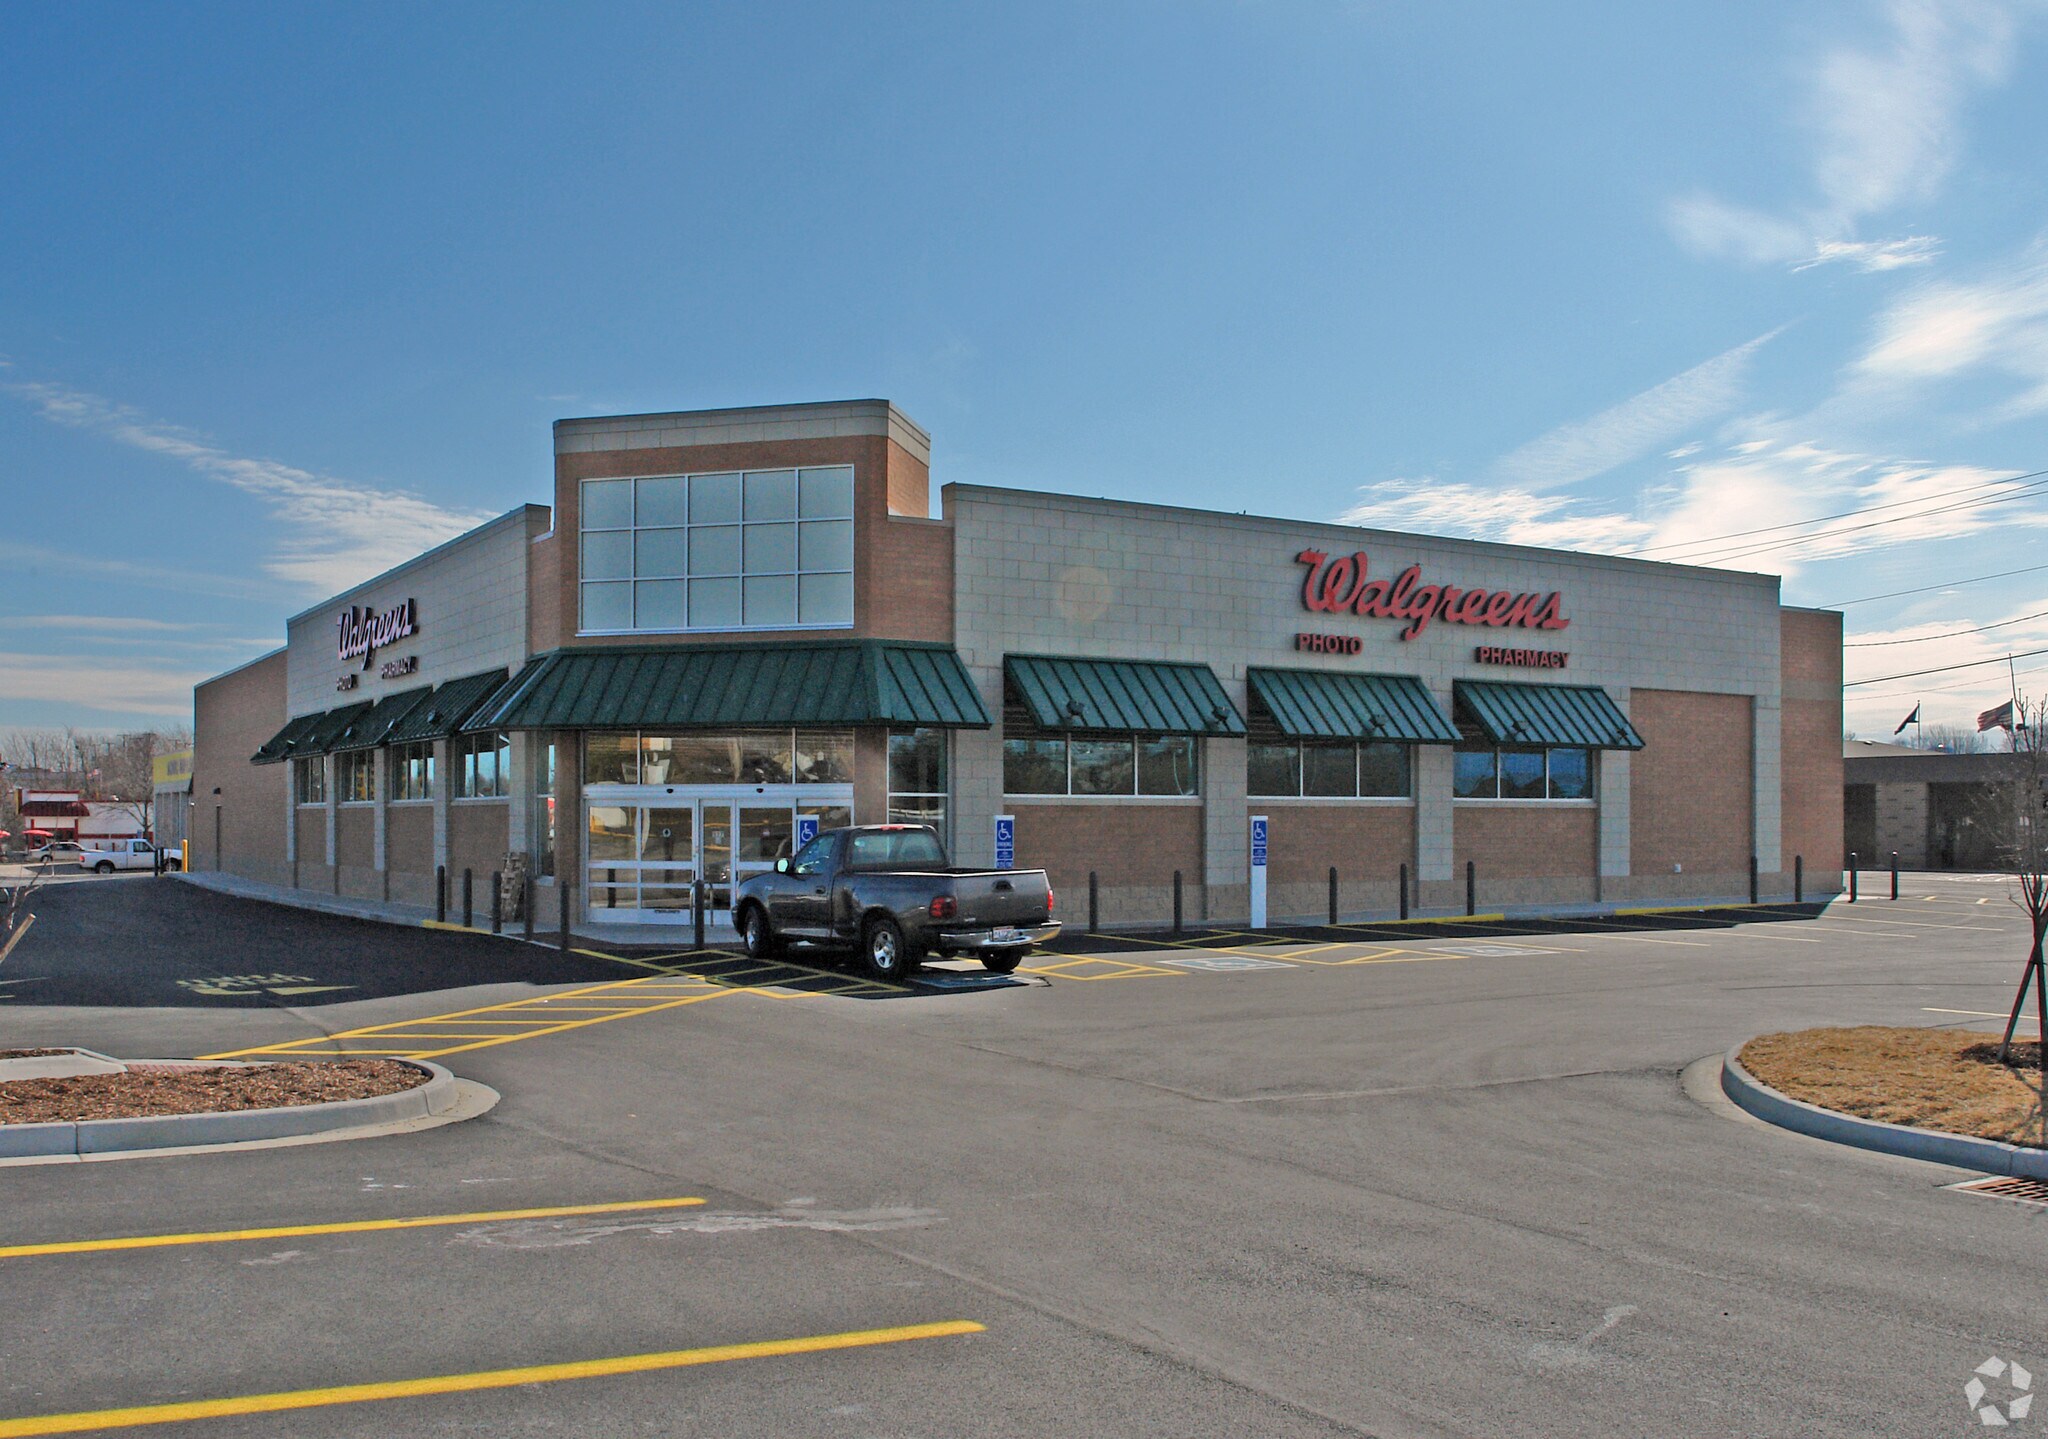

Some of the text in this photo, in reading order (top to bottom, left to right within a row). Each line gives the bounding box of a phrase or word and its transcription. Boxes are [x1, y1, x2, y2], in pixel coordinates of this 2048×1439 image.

[1295, 549, 1571, 641] Walgreens
[336, 598, 417, 671] Walgreens
[1296, 633, 1364, 656] PHOTO
[1475, 646, 1569, 668] PHARMACY
